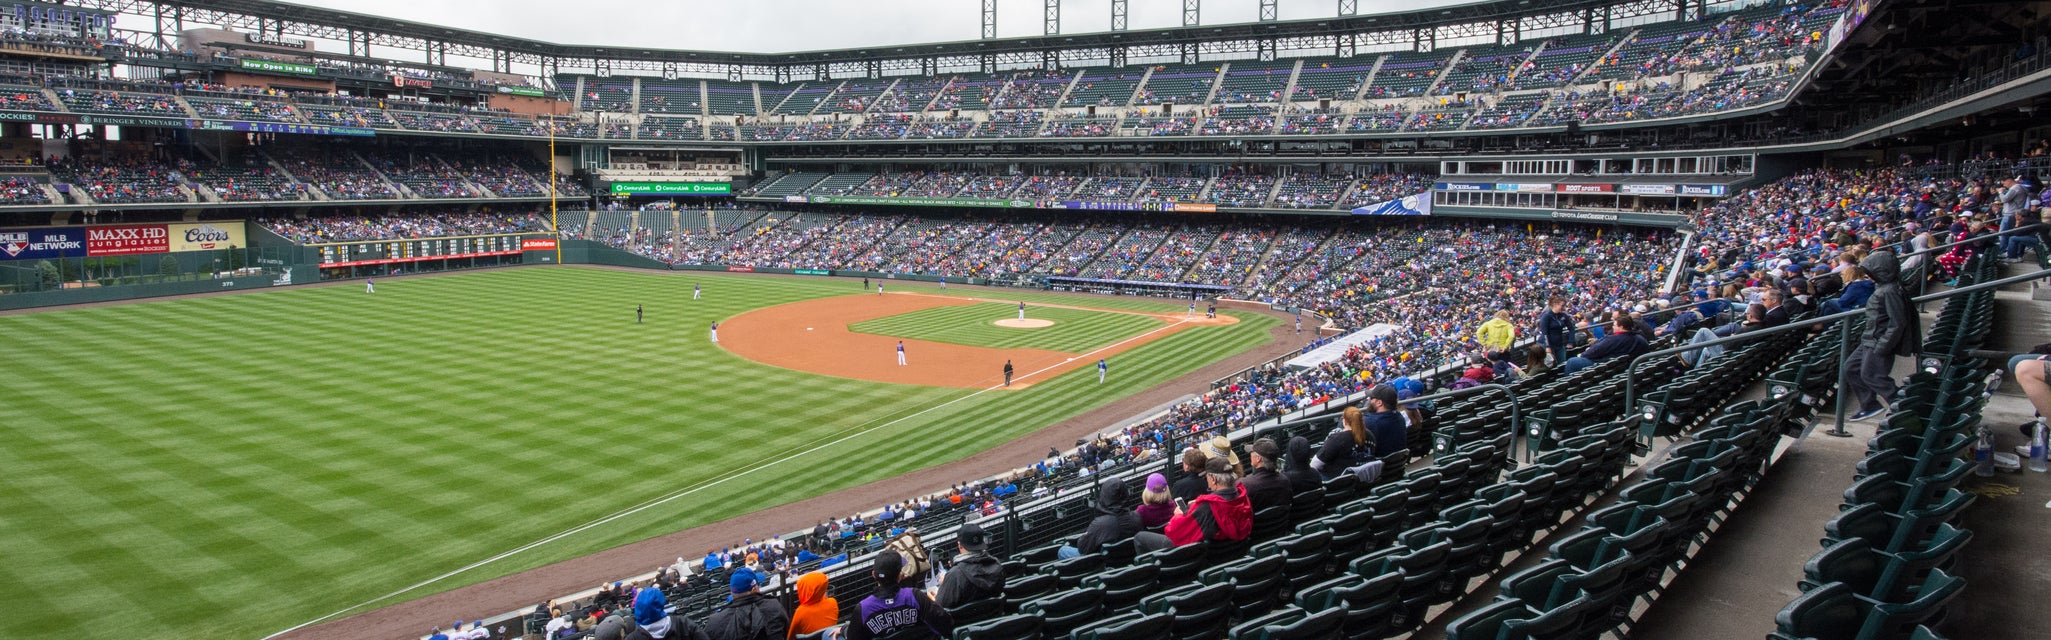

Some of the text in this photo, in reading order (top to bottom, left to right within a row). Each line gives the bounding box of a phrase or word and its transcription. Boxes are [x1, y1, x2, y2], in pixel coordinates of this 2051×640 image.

[14, 4, 116, 29] ROOFTOP
[93, 117, 135, 125] BERINGER
[44, 234, 67, 242] MLB
[89, 227, 166, 240] MAXX HD
[184, 228, 229, 242] Coors
[29, 241, 81, 251] NETWORK
[89, 239, 166, 247] sunglasses
[866, 609, 917, 634] HEFNER
